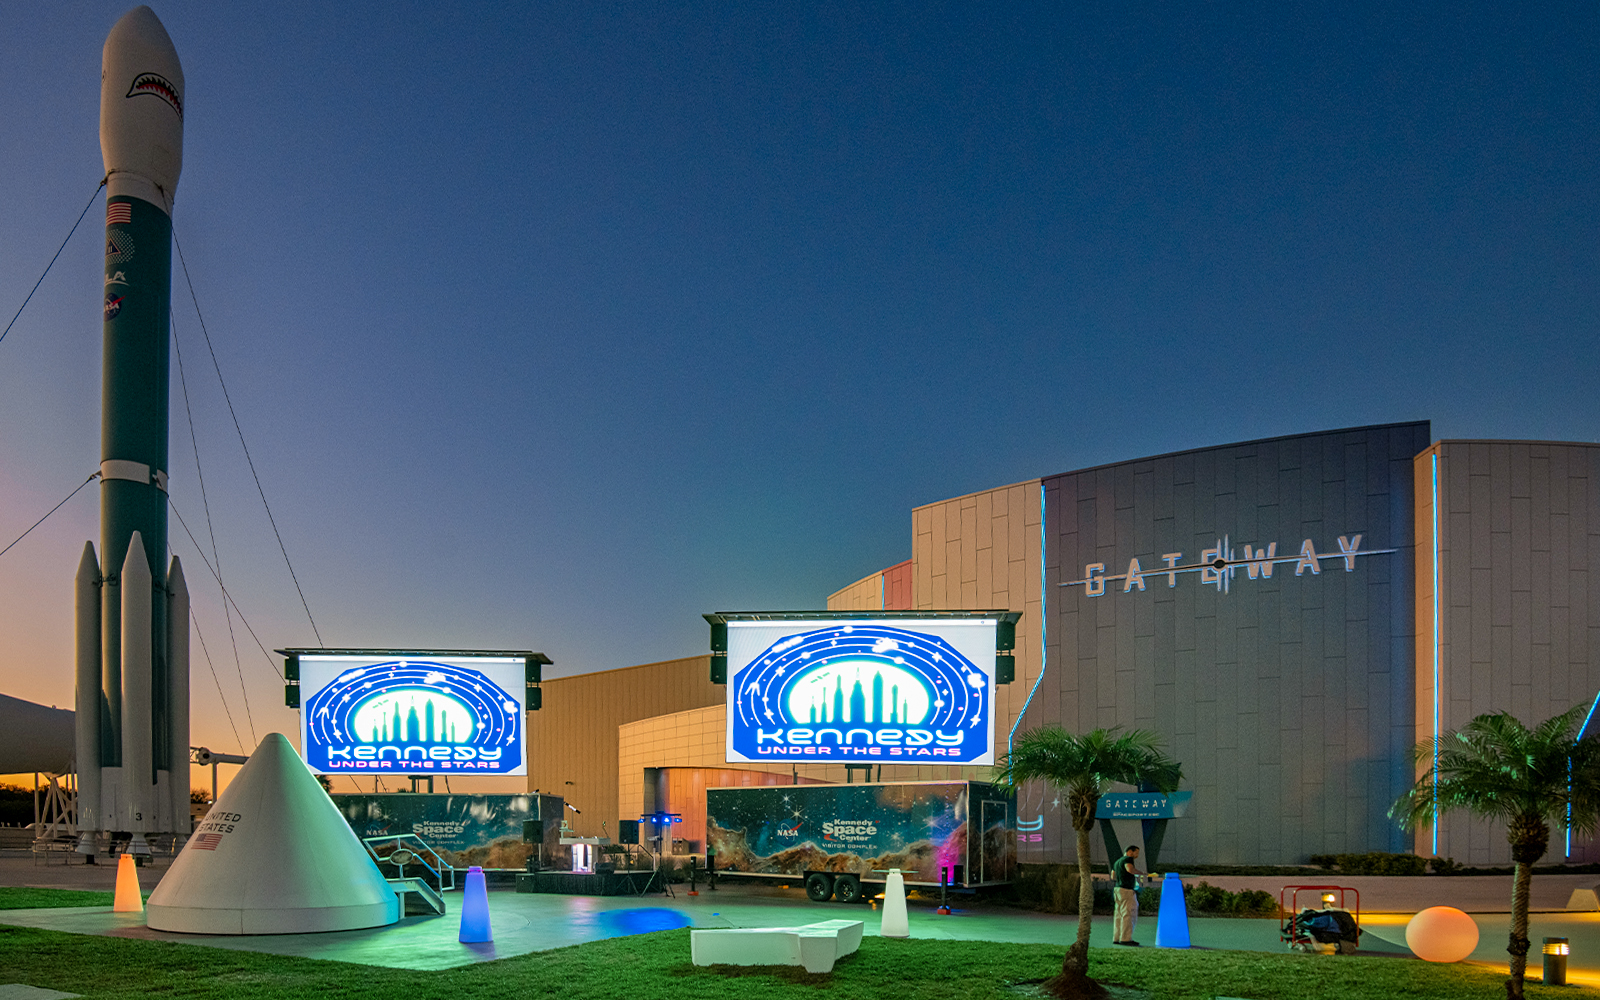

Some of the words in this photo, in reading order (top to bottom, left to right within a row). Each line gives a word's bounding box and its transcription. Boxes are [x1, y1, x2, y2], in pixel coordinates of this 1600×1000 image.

[1085, 534, 1363, 597] GATEWAY
[757, 746, 831, 755] UNDER
[839, 747, 882, 755] THE
[889, 747, 962, 756] STARS
[441, 761, 500, 769] STARS
[1105, 799, 1167, 809] GATEWAY
[135, 812, 142, 821] 3
[205, 812, 242, 822] UNITED
[198, 822, 235, 834] STATES
[412, 823, 464, 835] Space
[777, 829, 798, 837] NASA
[822, 822, 877, 836] Space
